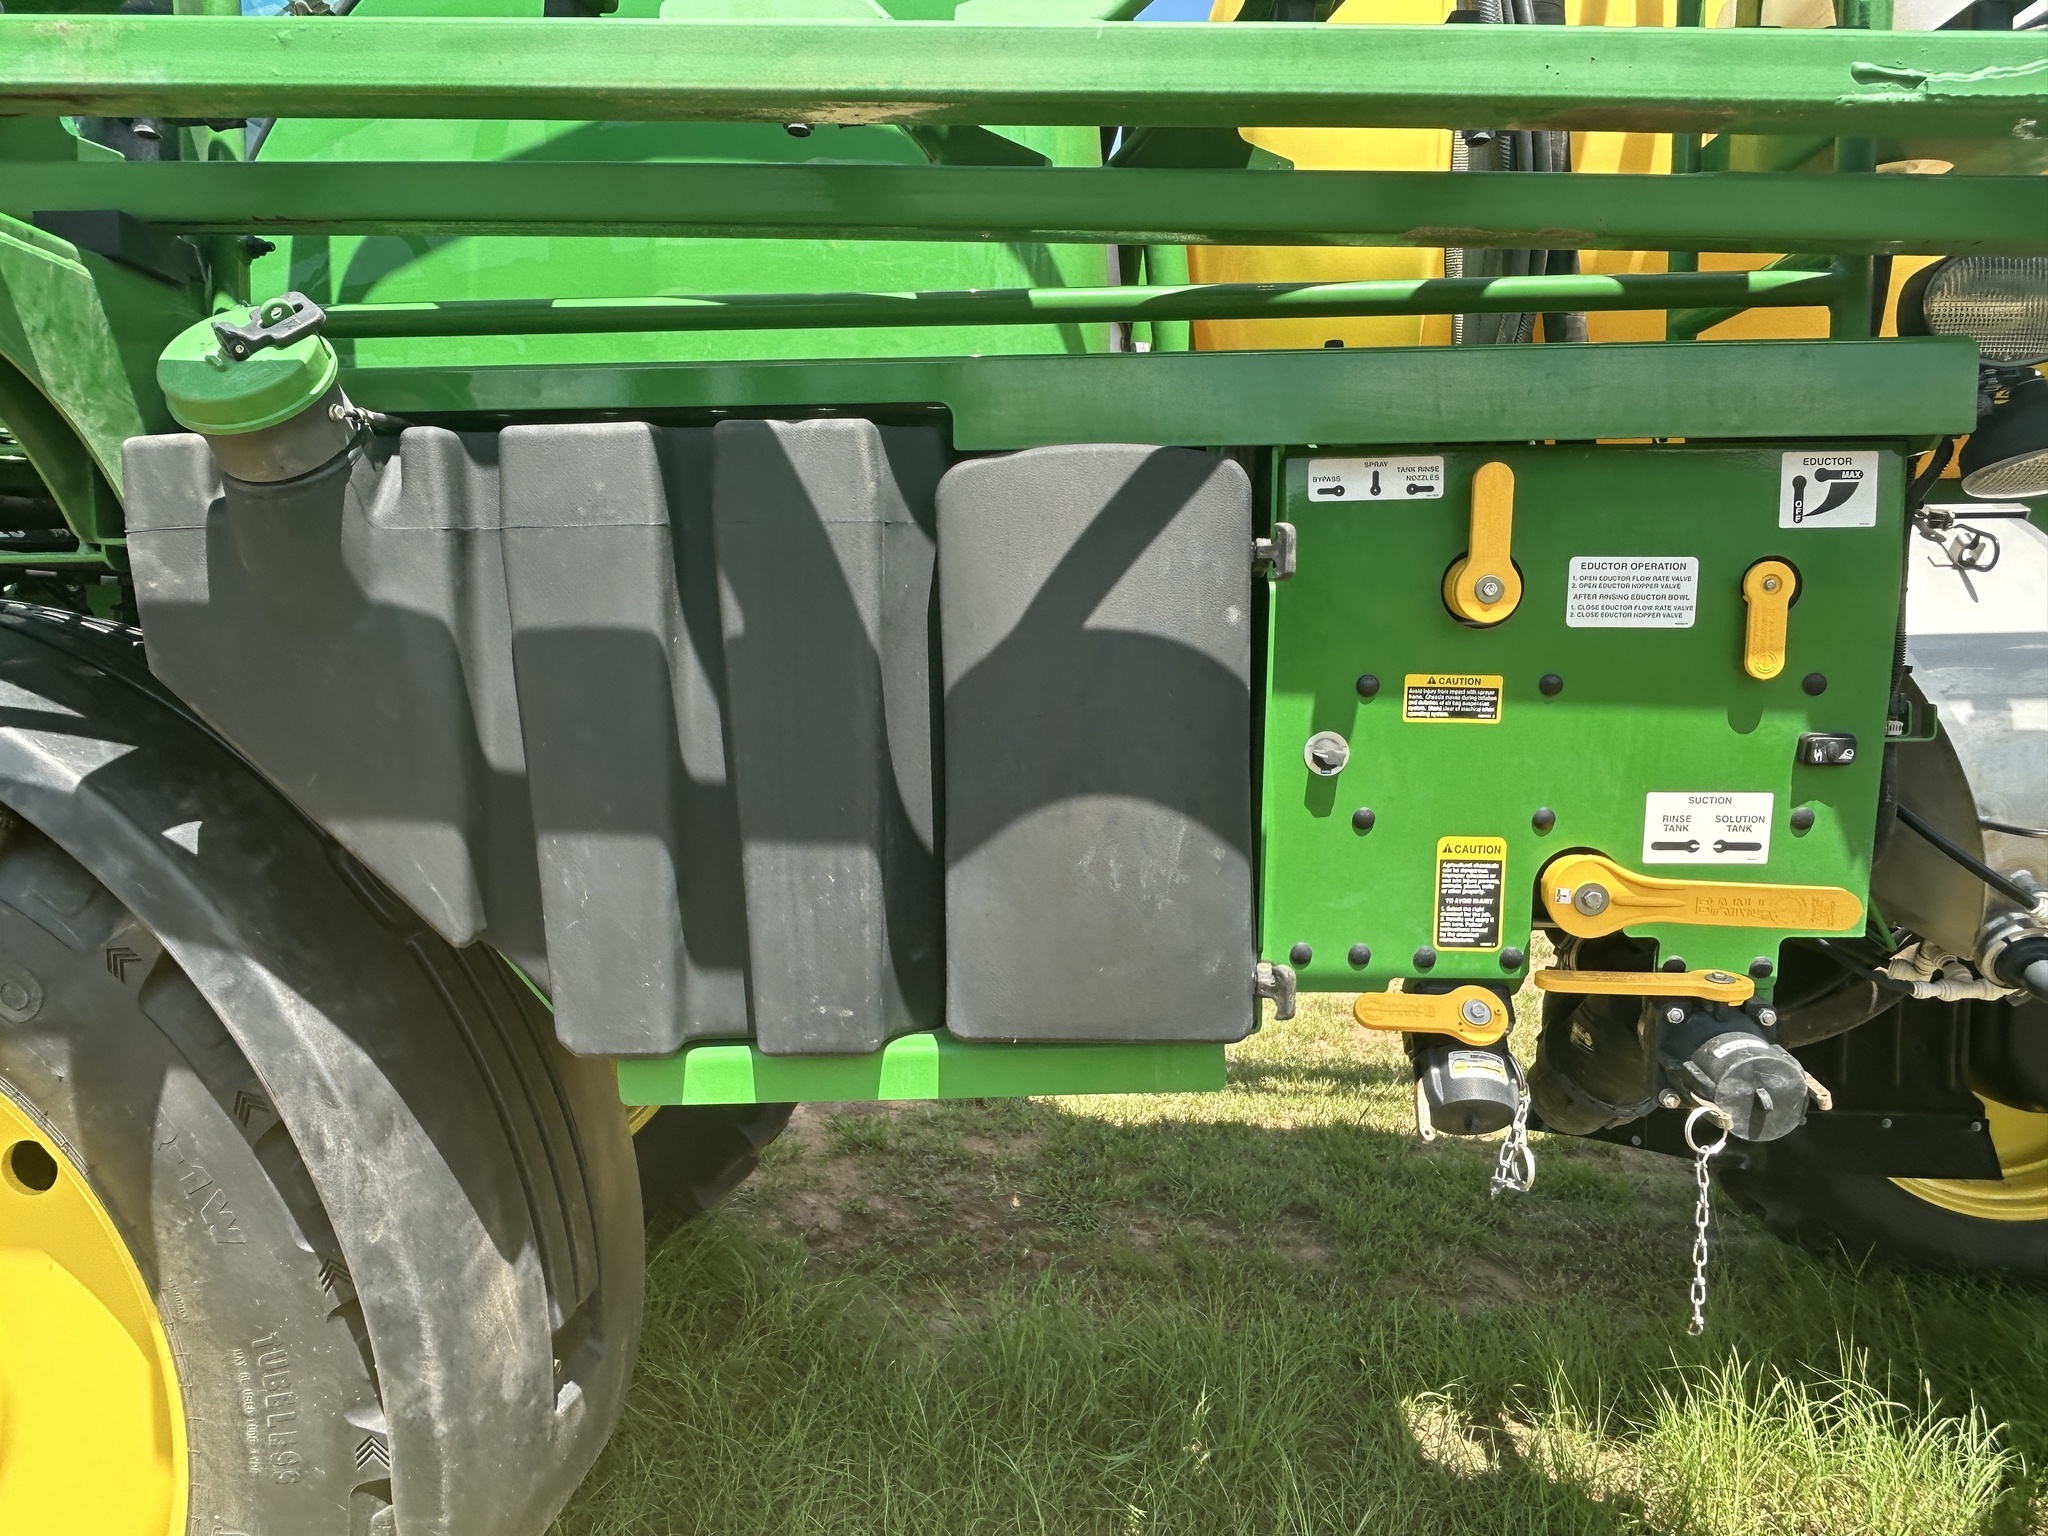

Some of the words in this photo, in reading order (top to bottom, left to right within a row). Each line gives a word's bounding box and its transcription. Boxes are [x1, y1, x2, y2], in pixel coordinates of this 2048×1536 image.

[1803, 457, 1852, 466] EDUCTOR
[1417, 465, 1440, 473] RINSE
[1312, 475, 1341, 483] BYPASS
[1841, 470, 1861, 479] MAX
[1794, 500, 1803, 523] OFF
[1580, 562, 1628, 571] EDUCTOR
[1630, 562, 1687, 571] OPERATION
[1573, 593, 1597, 601] AFTER
[1599, 593, 1629, 601] RINSING
[1631, 593, 1667, 601] EDUCTOR
[1668, 593, 1690, 601] BOWL
[1438, 677, 1482, 686] CAUTION
[1688, 796, 1733, 805] SUCTION
[1662, 814, 1692, 823] RINSE
[1715, 815, 1766, 823] SOLUTION
[1663, 824, 1690, 832] TANK
[1726, 824, 1753, 832] TANK
[1454, 844, 1501, 854] CAUTION
